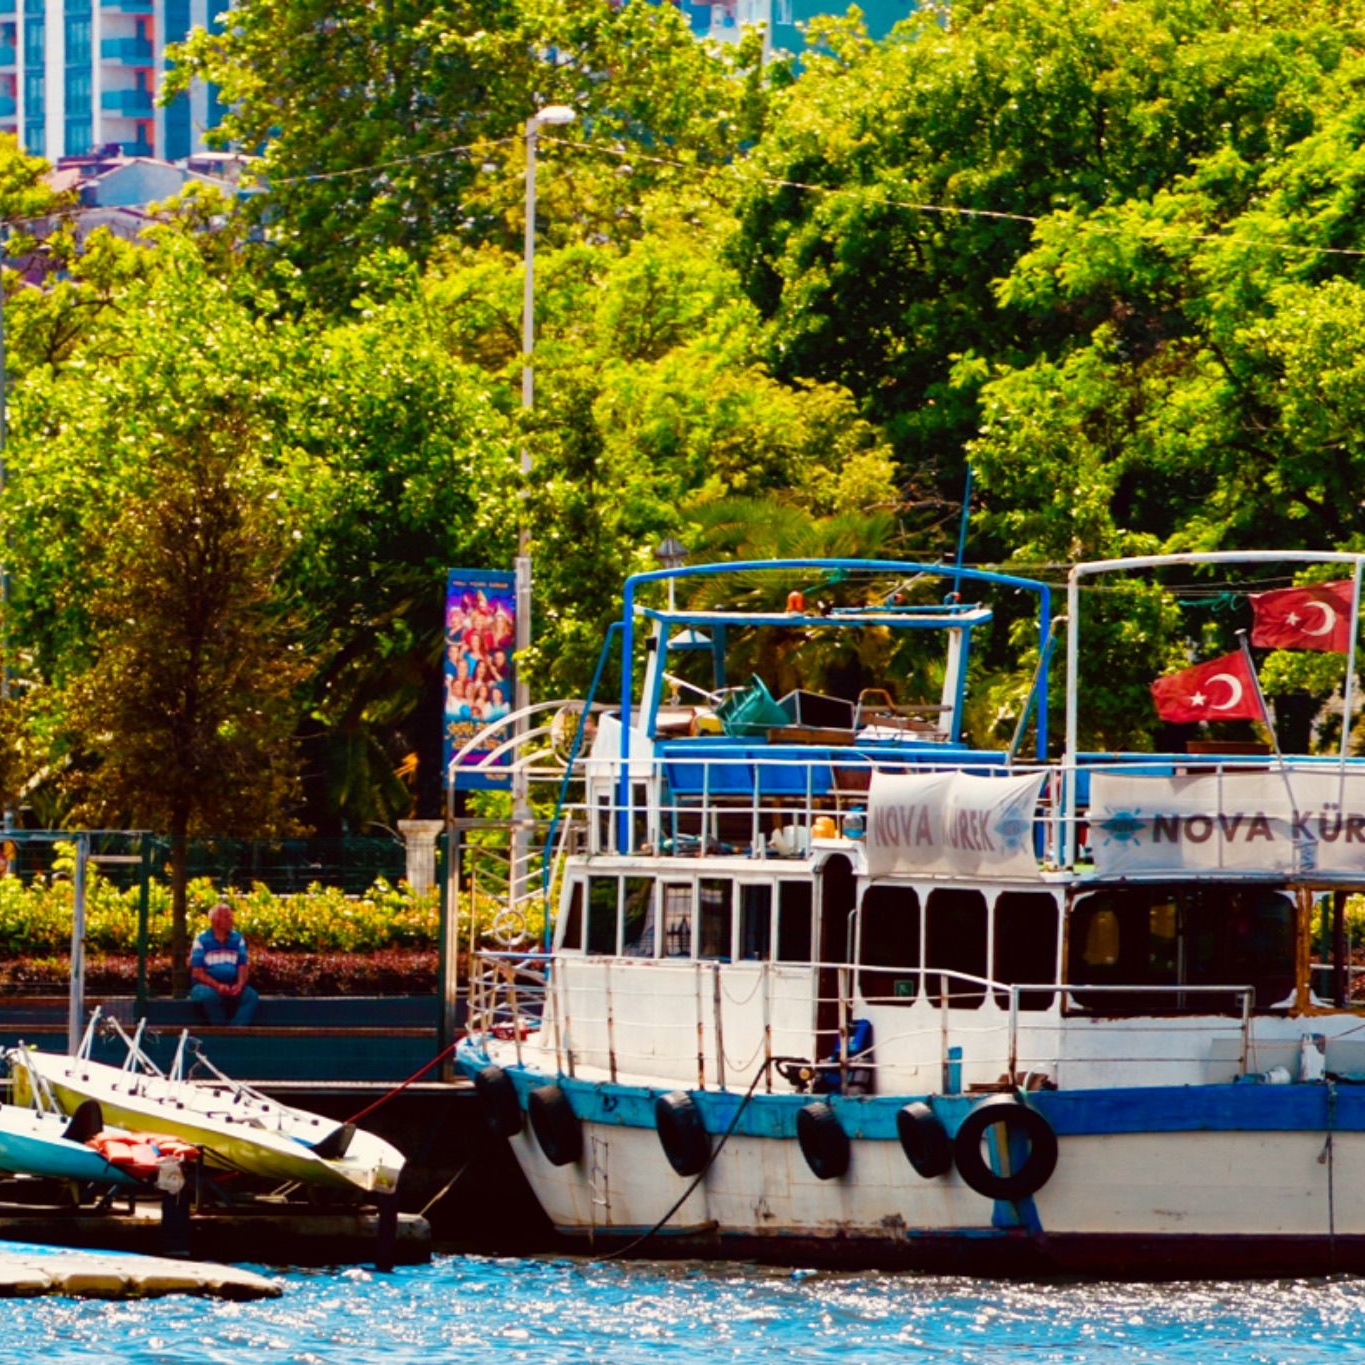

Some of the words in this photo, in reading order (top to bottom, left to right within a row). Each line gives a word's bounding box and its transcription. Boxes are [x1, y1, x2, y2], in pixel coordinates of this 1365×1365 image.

[873, 803, 934, 848] NOVA
[940, 795, 996, 852] ÜREK
[1152, 811, 1275, 844] NOVA
[1291, 802, 1365, 844] KÜR
